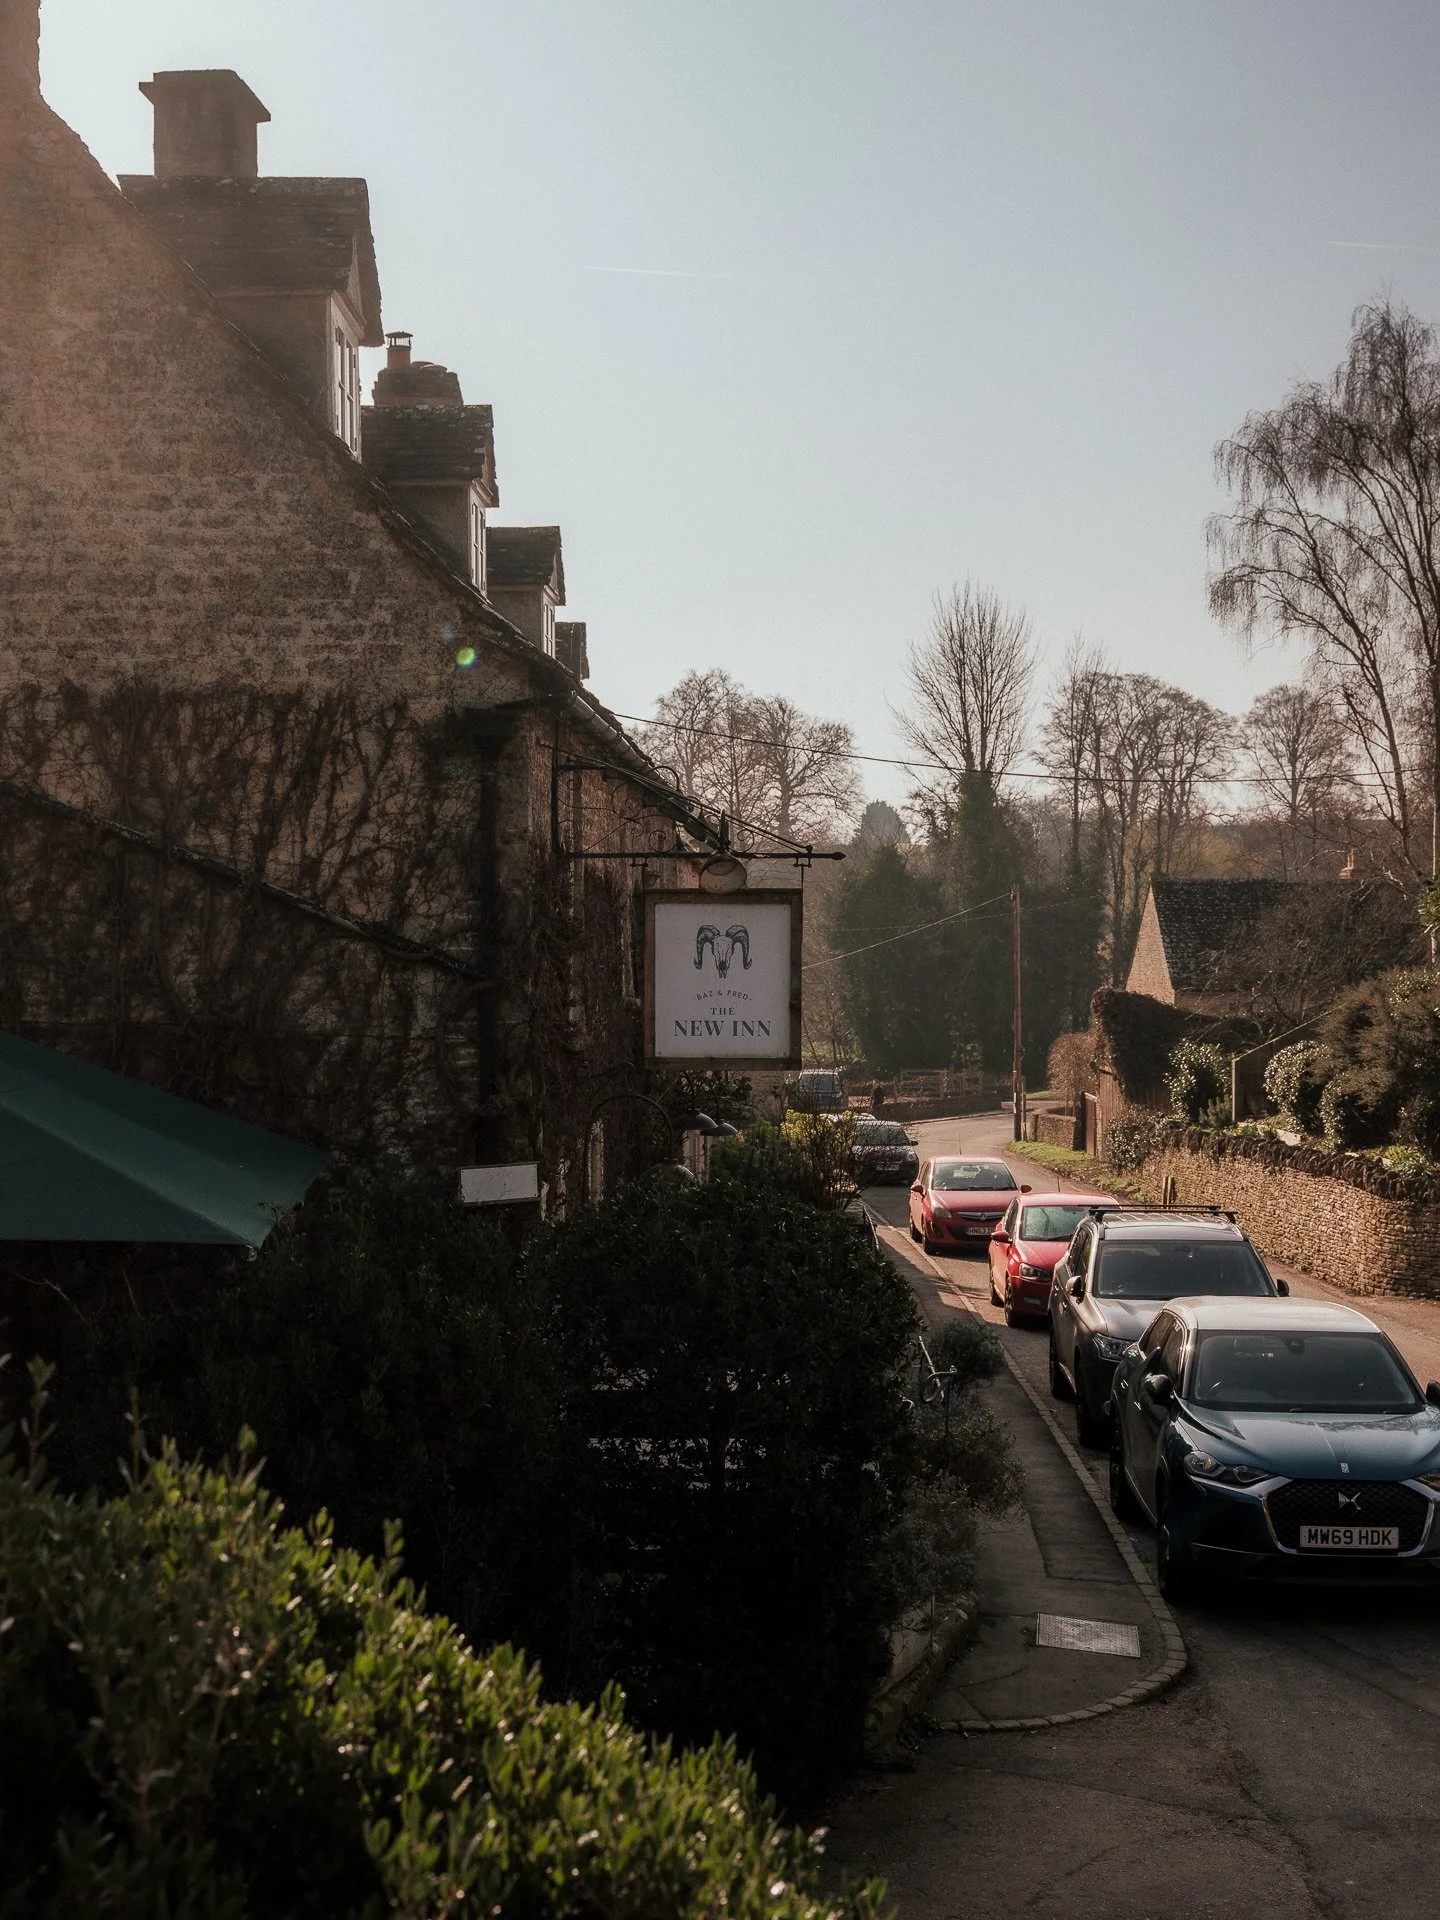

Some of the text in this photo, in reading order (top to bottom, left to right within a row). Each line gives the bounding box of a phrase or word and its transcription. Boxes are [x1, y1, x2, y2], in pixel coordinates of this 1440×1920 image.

[696, 990, 714, 1001] BAZ
[727, 989, 749, 1001] FRED
[710, 1007, 735, 1016] THE
[674, 1020, 771, 1037] NEW INN
[1307, 1528, 1392, 1545] MW69 HDK
